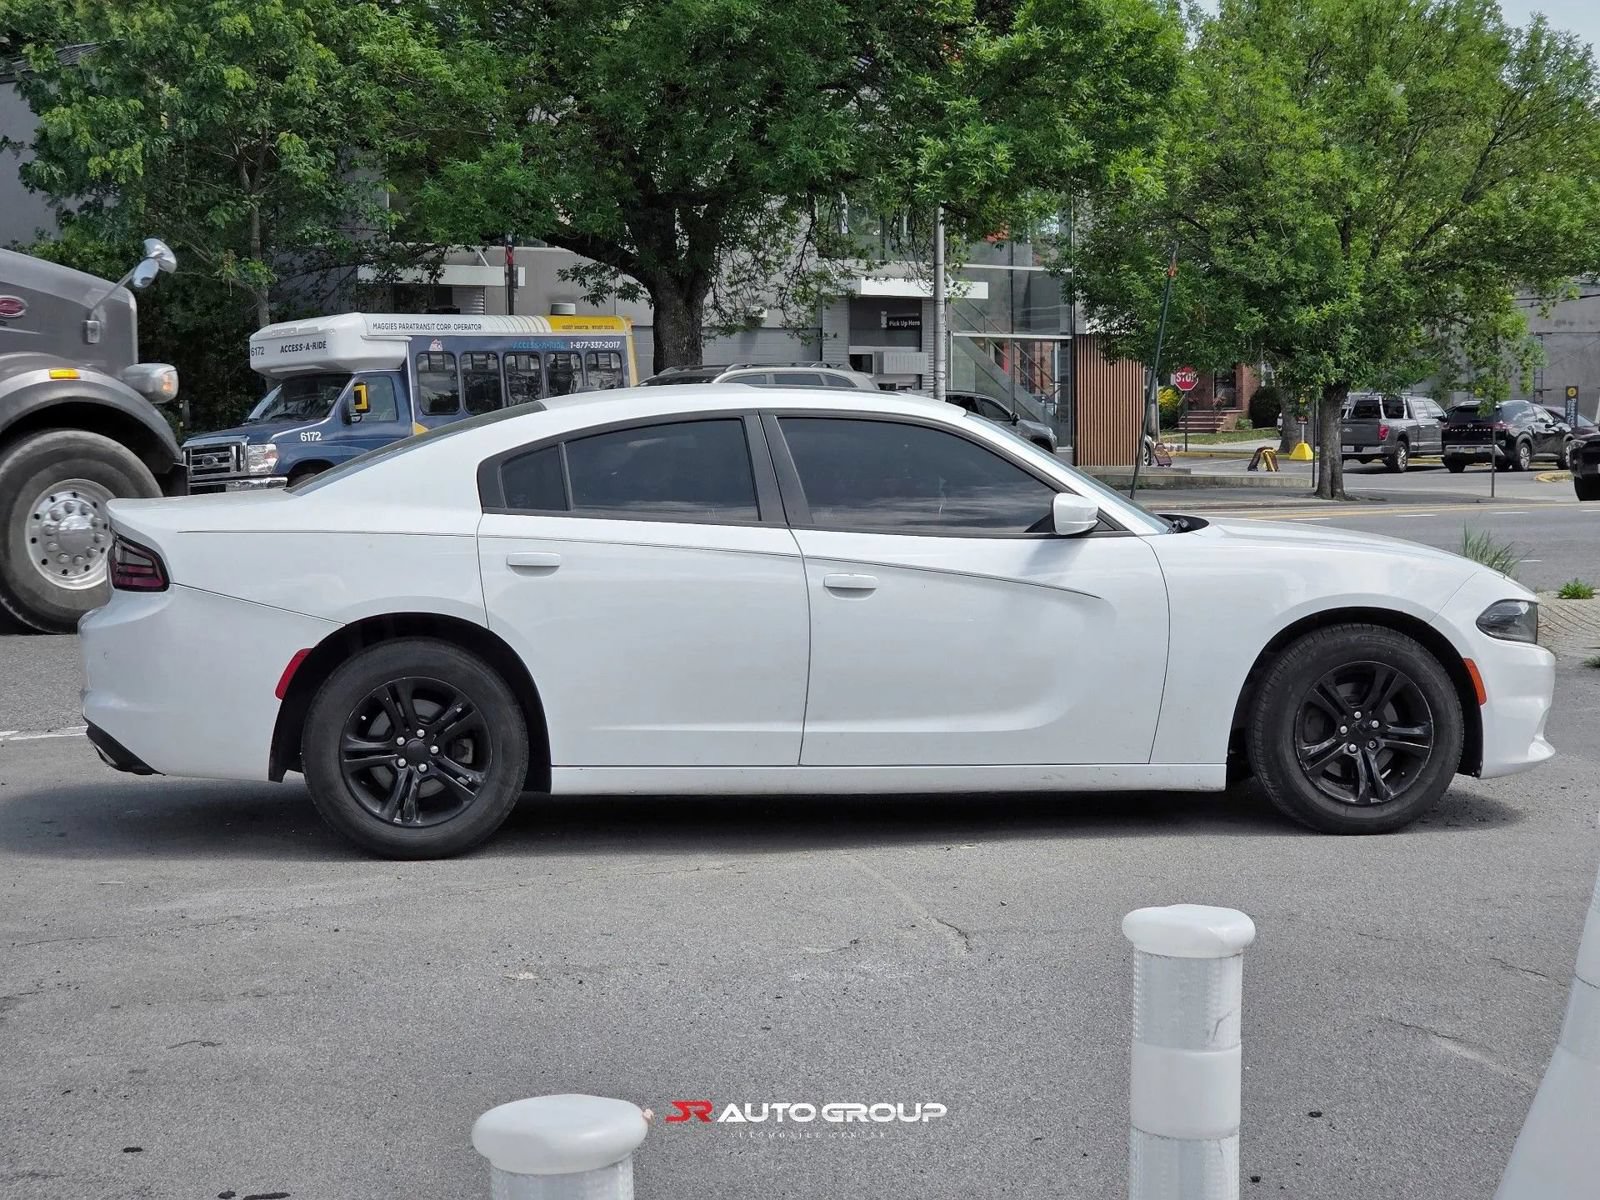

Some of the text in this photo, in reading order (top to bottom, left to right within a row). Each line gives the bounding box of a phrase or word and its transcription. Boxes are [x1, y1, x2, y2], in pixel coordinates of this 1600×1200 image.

[372, 322, 398, 330] MAGGIES
[398, 322, 436, 330] PARATRANSIT
[453, 323, 482, 331] OPERATOR
[900, 320, 908, 328] Up
[280, 340, 327, 353] ACCESS-A-RIDE
[570, 341, 621, 349] 1-877-337-2017
[250, 346, 265, 356] 6172
[1176, 372, 1197, 382] STOP
[300, 431, 322, 442] 6172
